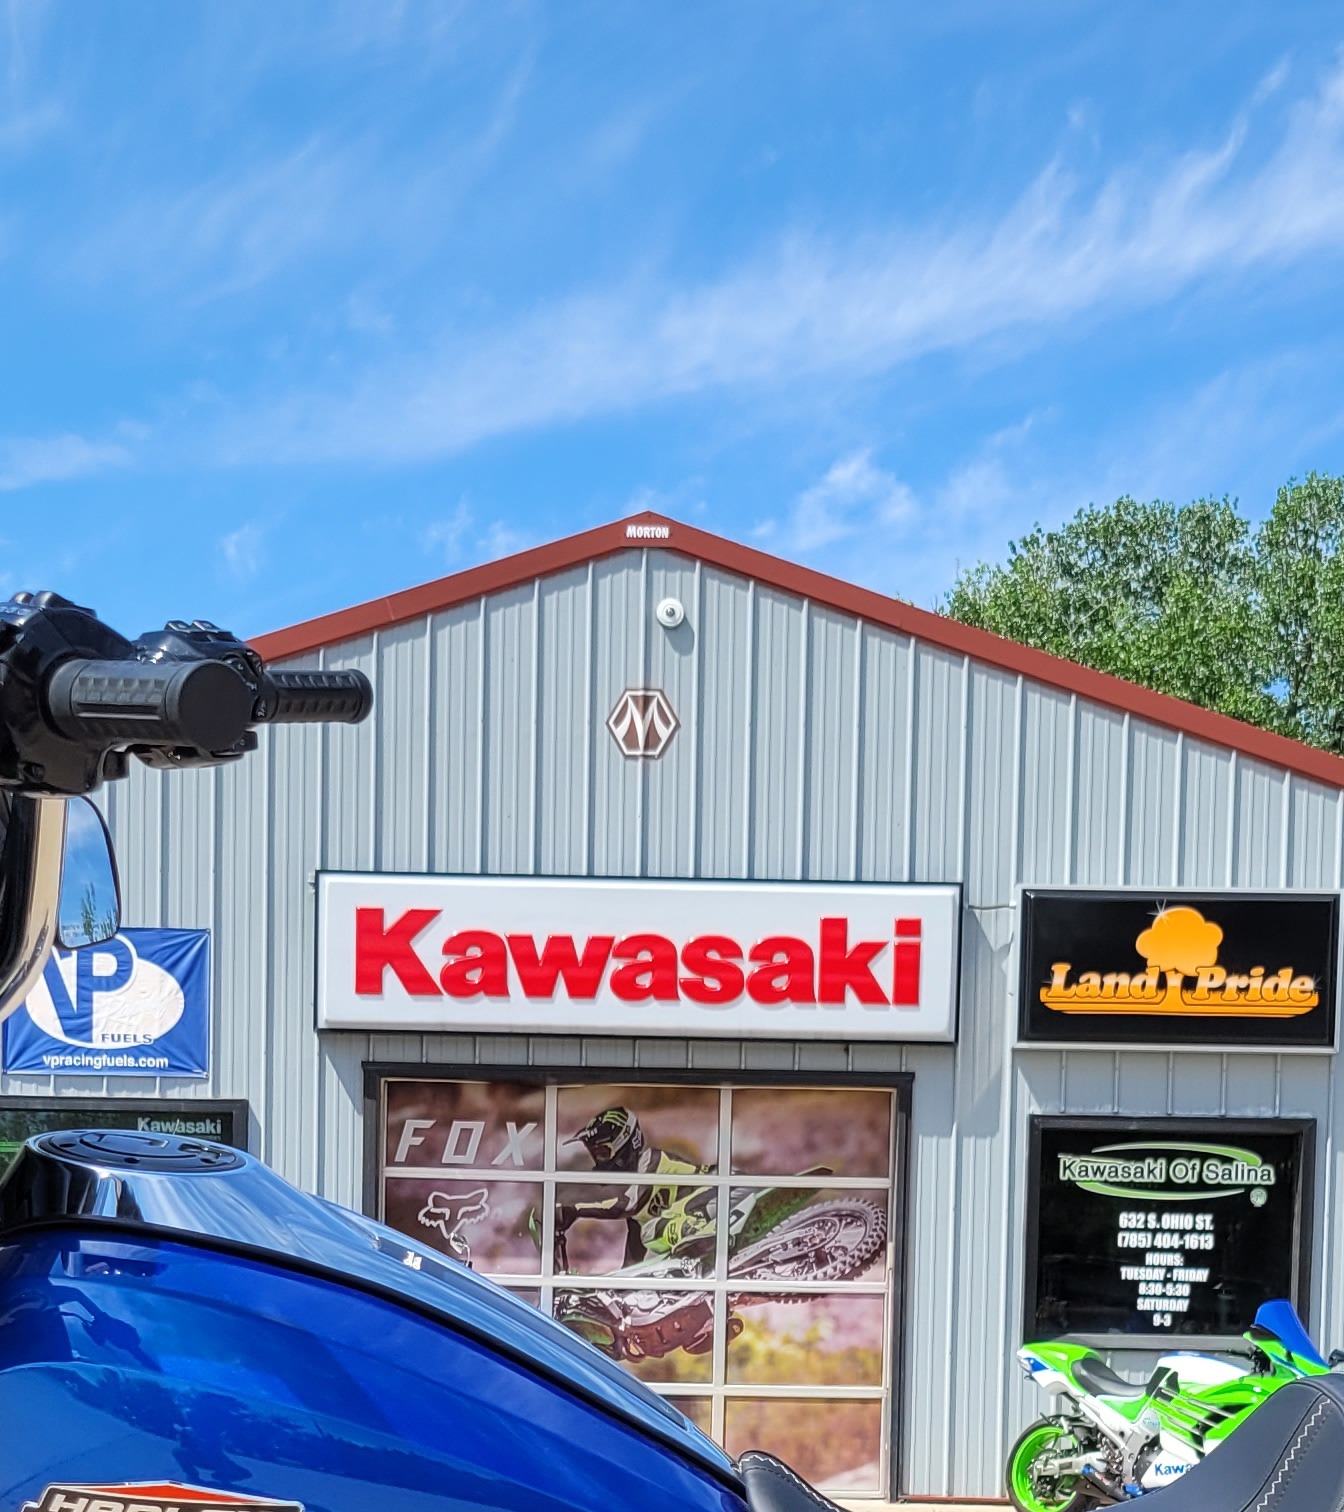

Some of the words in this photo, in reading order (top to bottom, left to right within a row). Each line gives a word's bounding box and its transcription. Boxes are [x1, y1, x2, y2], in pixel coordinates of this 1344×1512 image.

[626, 525, 669, 539] MORTON
[356, 907, 922, 1006] Kawasaki
[42, 935, 136, 1044] VP
[1047, 962, 1160, 1000] Land
[1191, 965, 1315, 1002] Pride
[101, 1033, 153, 1044] FUELS
[43, 1054, 169, 1070] vpracingfuels.com
[137, 1117, 222, 1134] Kawasaki
[394, 1119, 538, 1167] FOX
[1060, 1157, 1165, 1183] Kawasaki
[1171, 1160, 1198, 1183] Of
[1204, 1159, 1274, 1184] Salina
[1118, 1212, 1145, 1229] 632
[1147, 1212, 1160, 1230] S.
[1161, 1213, 1194, 1230] OHIO
[1195, 1214, 1214, 1231] ST.
[1117, 1231, 1153, 1249] (785)
[1153, 1232, 1215, 1250] 404-1613
[1145, 1252, 1185, 1267] HOURS:
[1120, 1266, 1167, 1281] TUESDAY
[1172, 1267, 1210, 1283] FRIDAY
[1138, 1281, 1191, 1297] 8:30-5:30
[1136, 1297, 1190, 1312] SATURDAY
